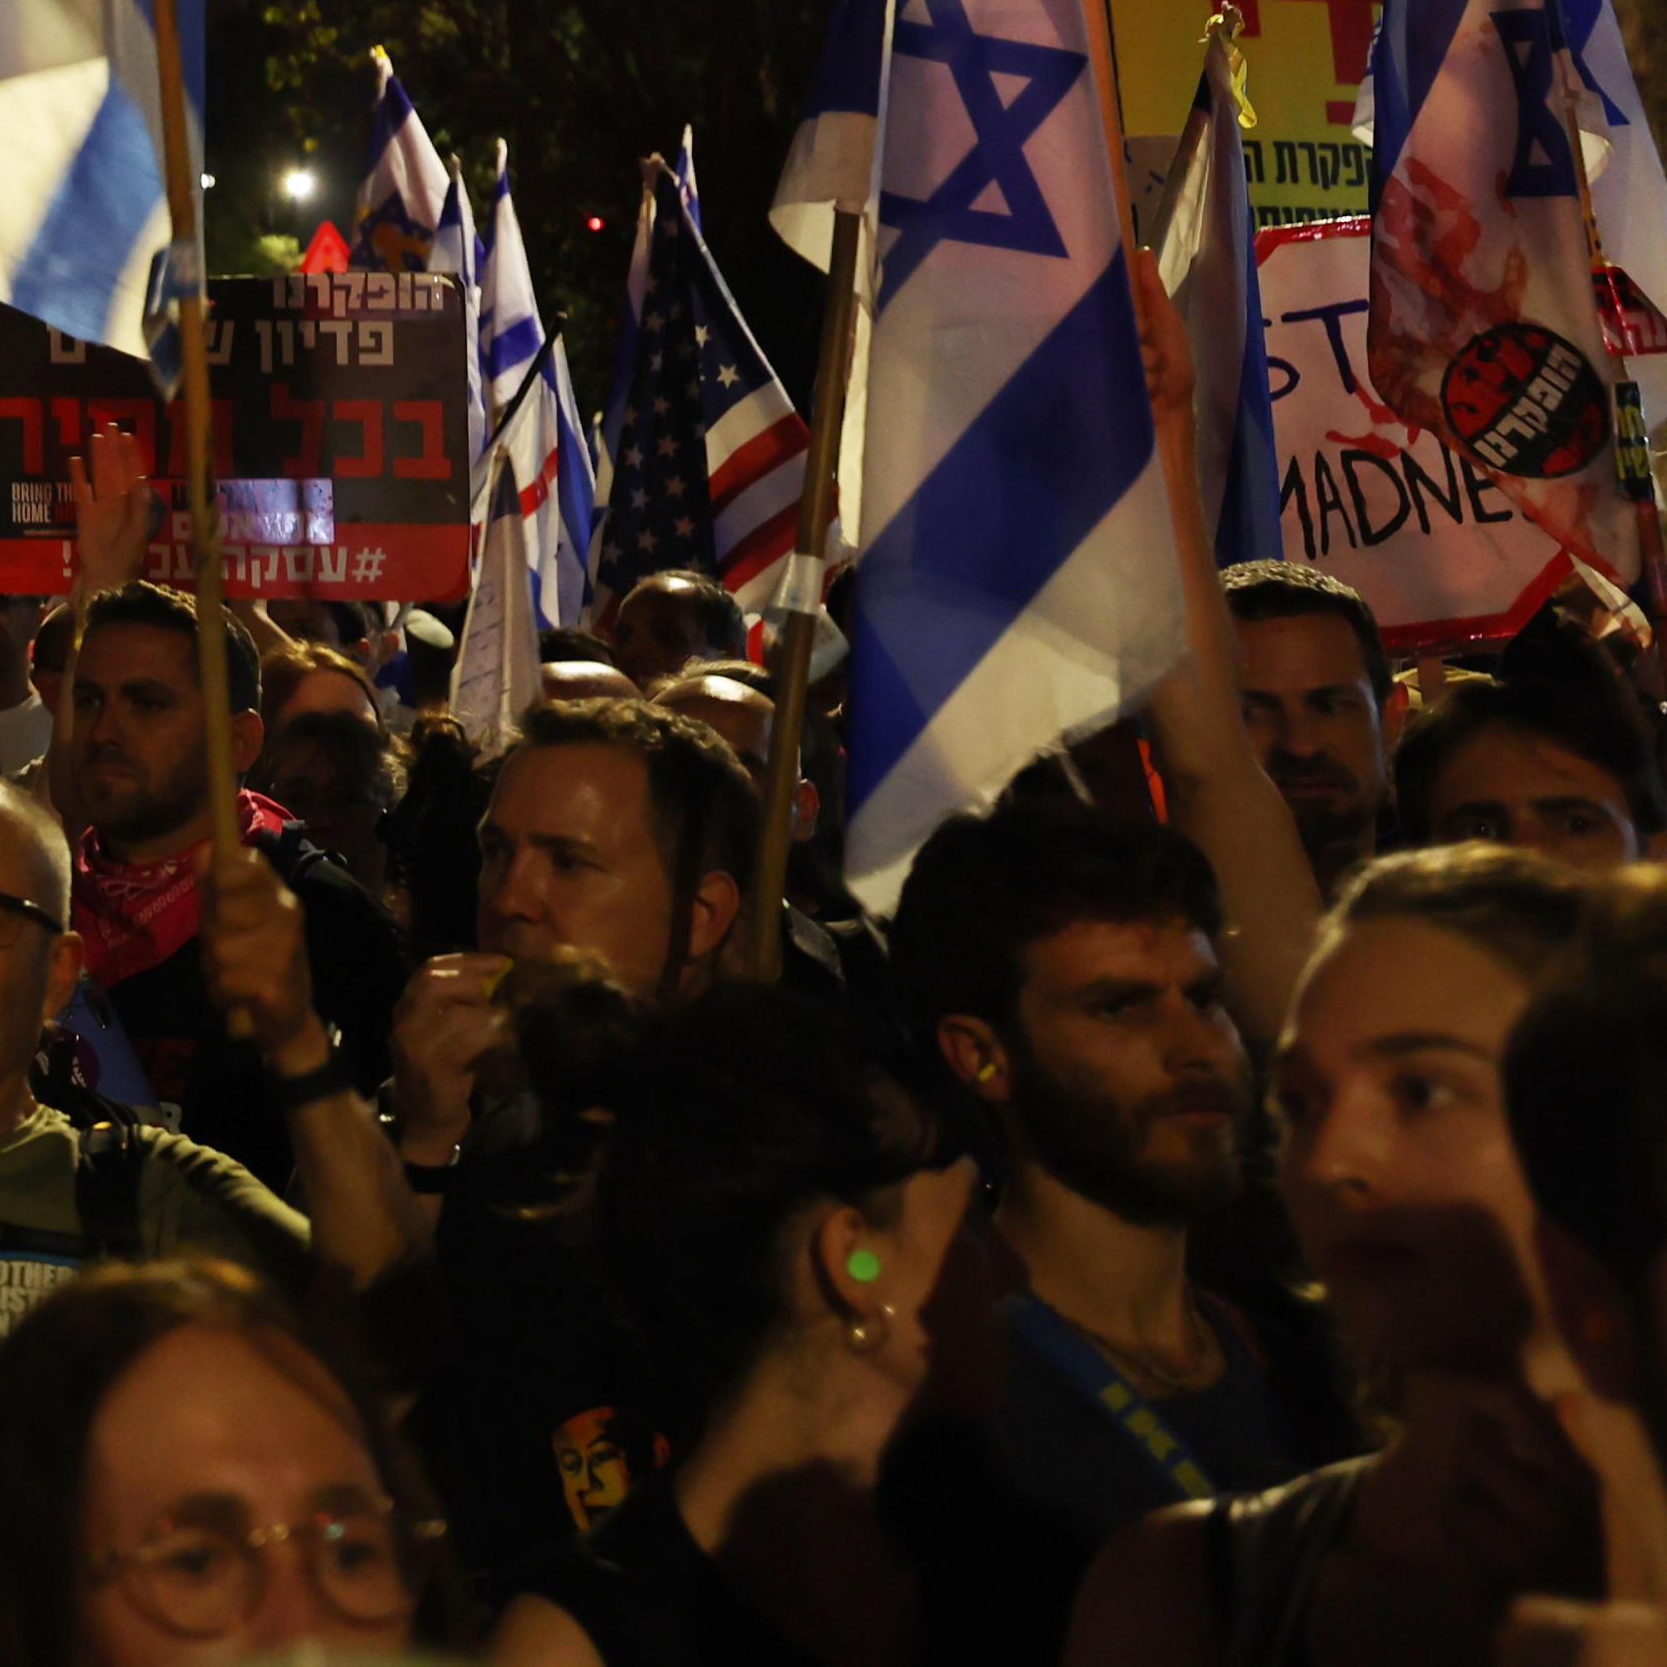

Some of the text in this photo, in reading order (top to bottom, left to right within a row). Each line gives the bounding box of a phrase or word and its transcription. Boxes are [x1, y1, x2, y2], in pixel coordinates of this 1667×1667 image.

[1273, 142, 1371, 190] פקרת
[272, 273, 444, 319] הופקרנו
[254, 319, 395, 374] פדיון
[269, 382, 453, 480] בכל
[1472, 340, 1584, 468] הופקרנו
